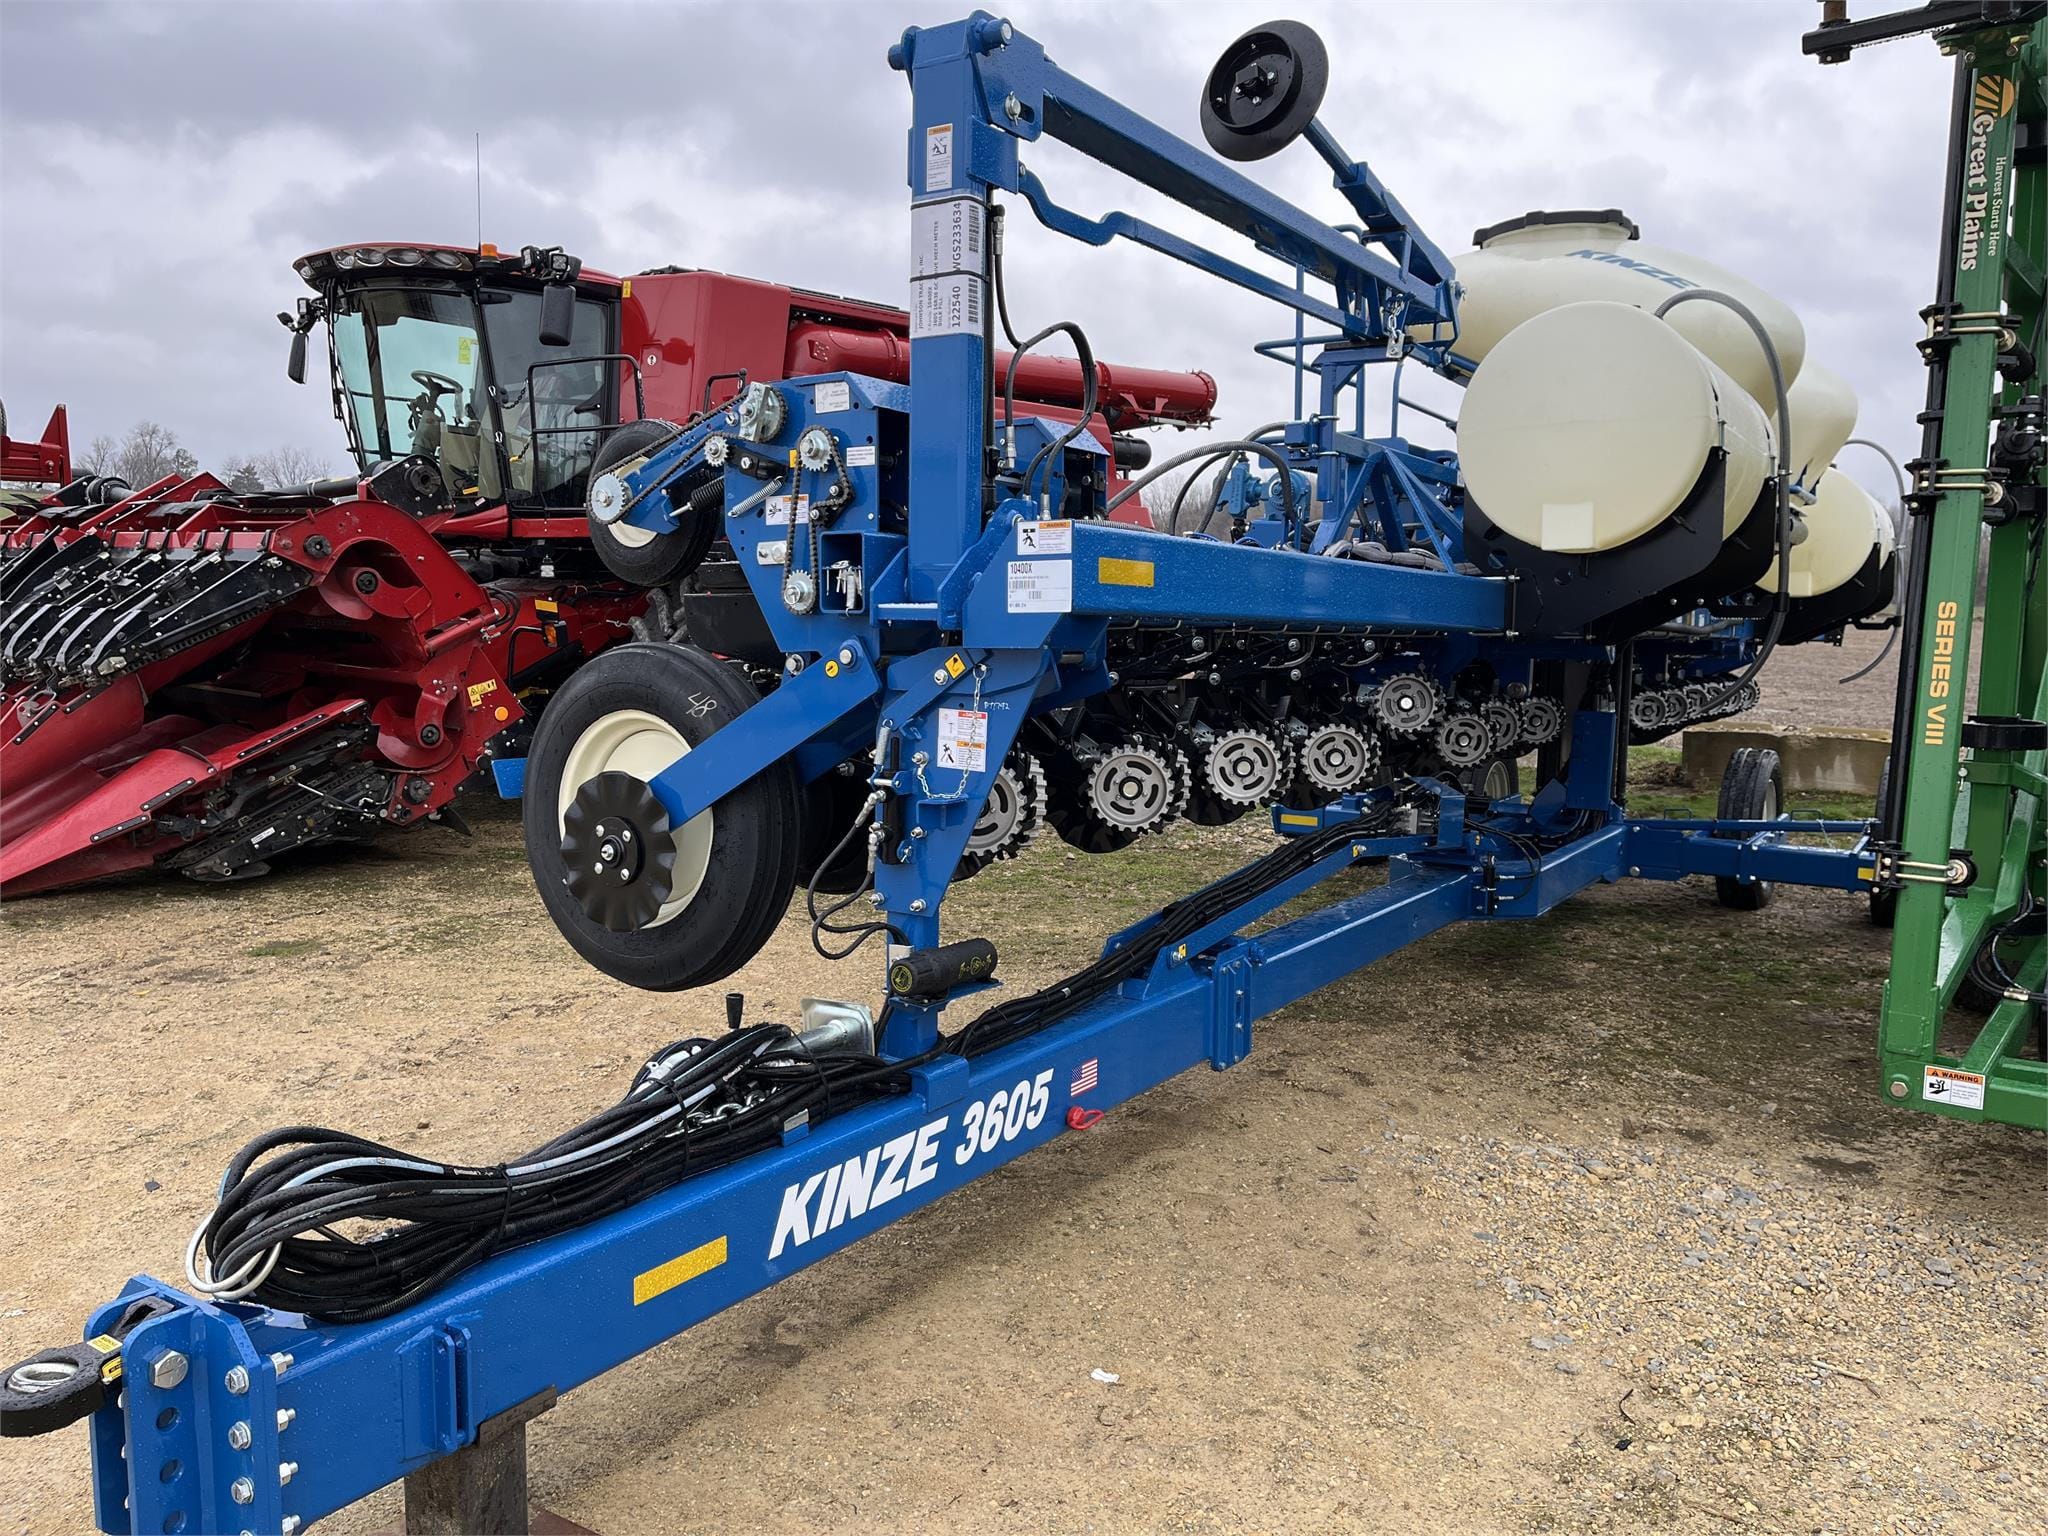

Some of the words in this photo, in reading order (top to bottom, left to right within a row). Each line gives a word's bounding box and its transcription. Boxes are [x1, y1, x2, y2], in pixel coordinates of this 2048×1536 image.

[1969, 114, 1995, 188] Great
[1993, 156, 2007, 197] Harvest
[1960, 191, 1988, 271] Plains
[1990, 198, 2003, 229] Starts
[1988, 231, 2001, 257] Here
[1564, 249, 1701, 289] KINZE
[952, 286, 961, 328] 122540
[1929, 601, 1957, 698] SERIES
[685, 691, 718, 718] 48
[1924, 704, 1947, 745] VIII
[1942, 1071, 1979, 1083] WARNING
[768, 1115, 949, 1261] KINZE
[955, 1068, 1054, 1166] 3605
